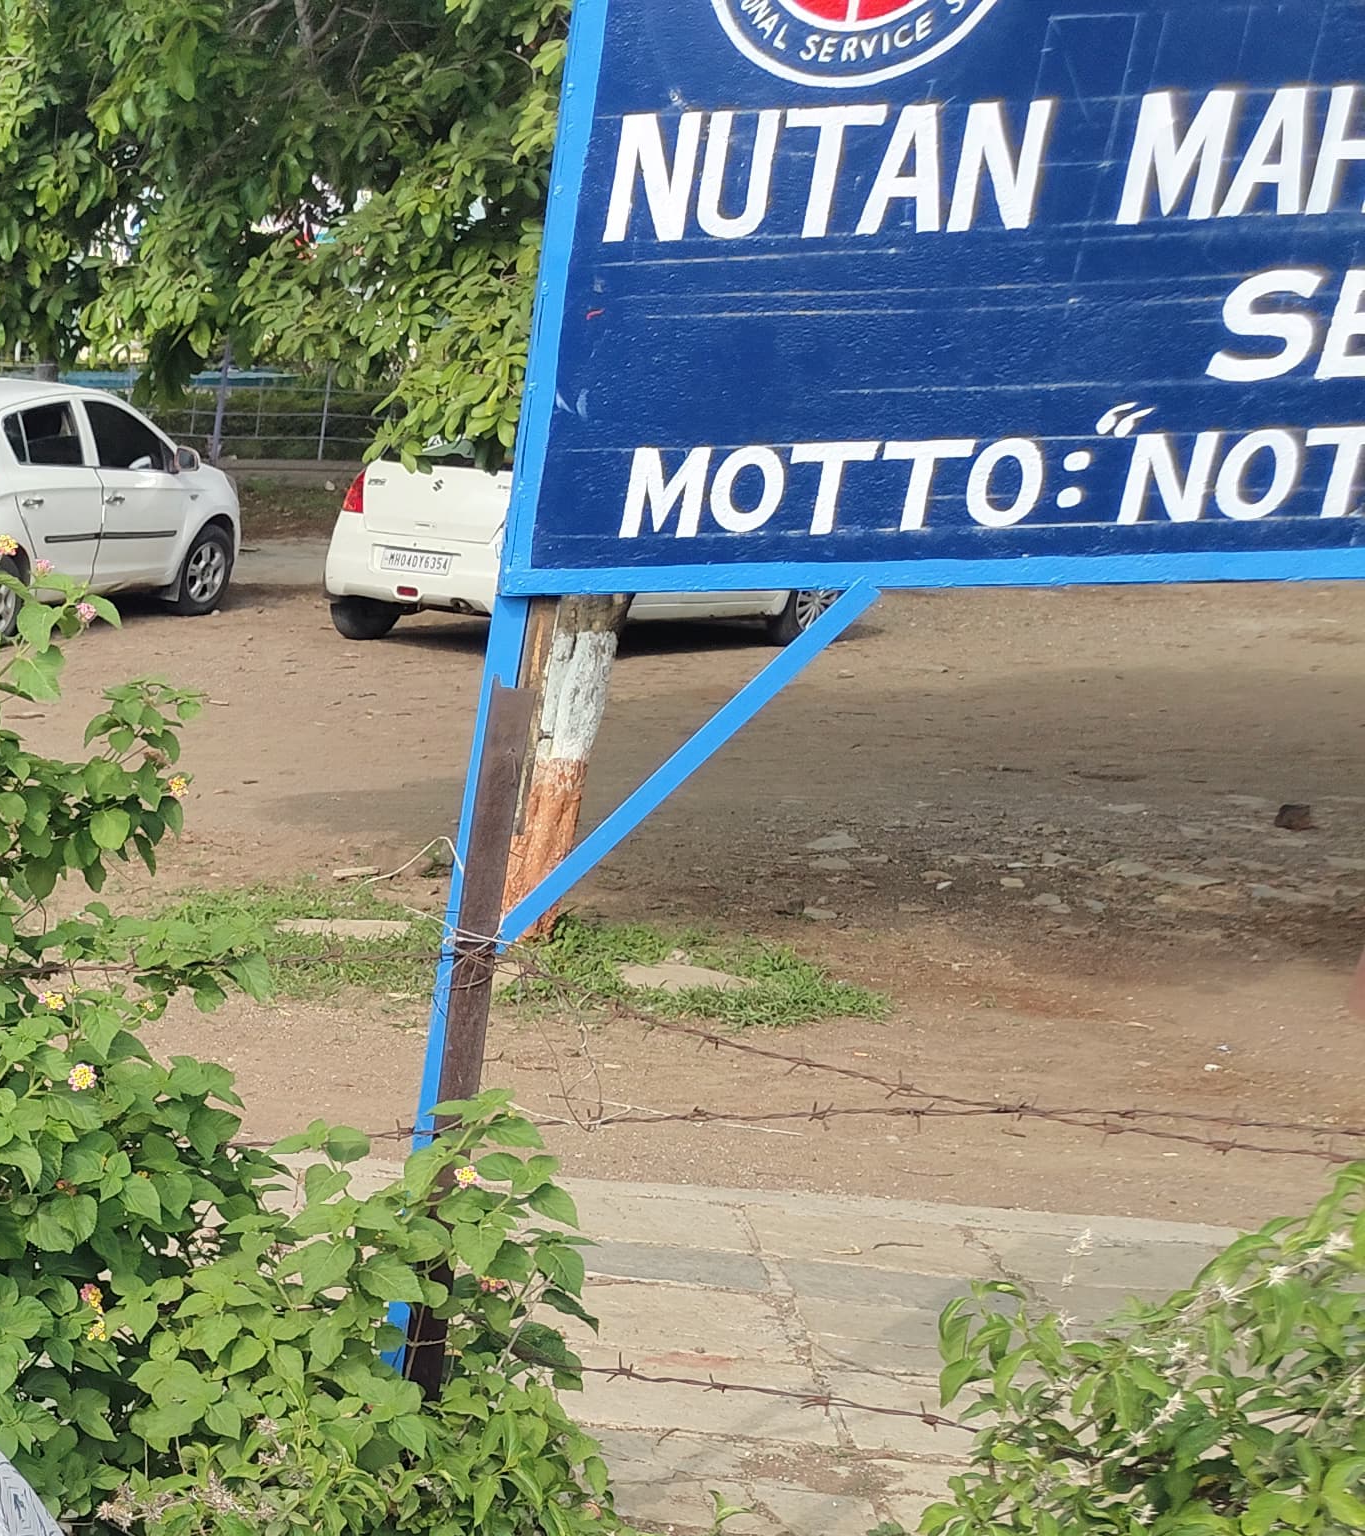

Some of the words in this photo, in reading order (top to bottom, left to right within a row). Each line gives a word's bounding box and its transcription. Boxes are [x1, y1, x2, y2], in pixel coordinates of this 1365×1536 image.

[799, 10, 933, 62] SERVICE
[603, 99, 1053, 243] NUTAN
[1205, 269, 1365, 382] SE
